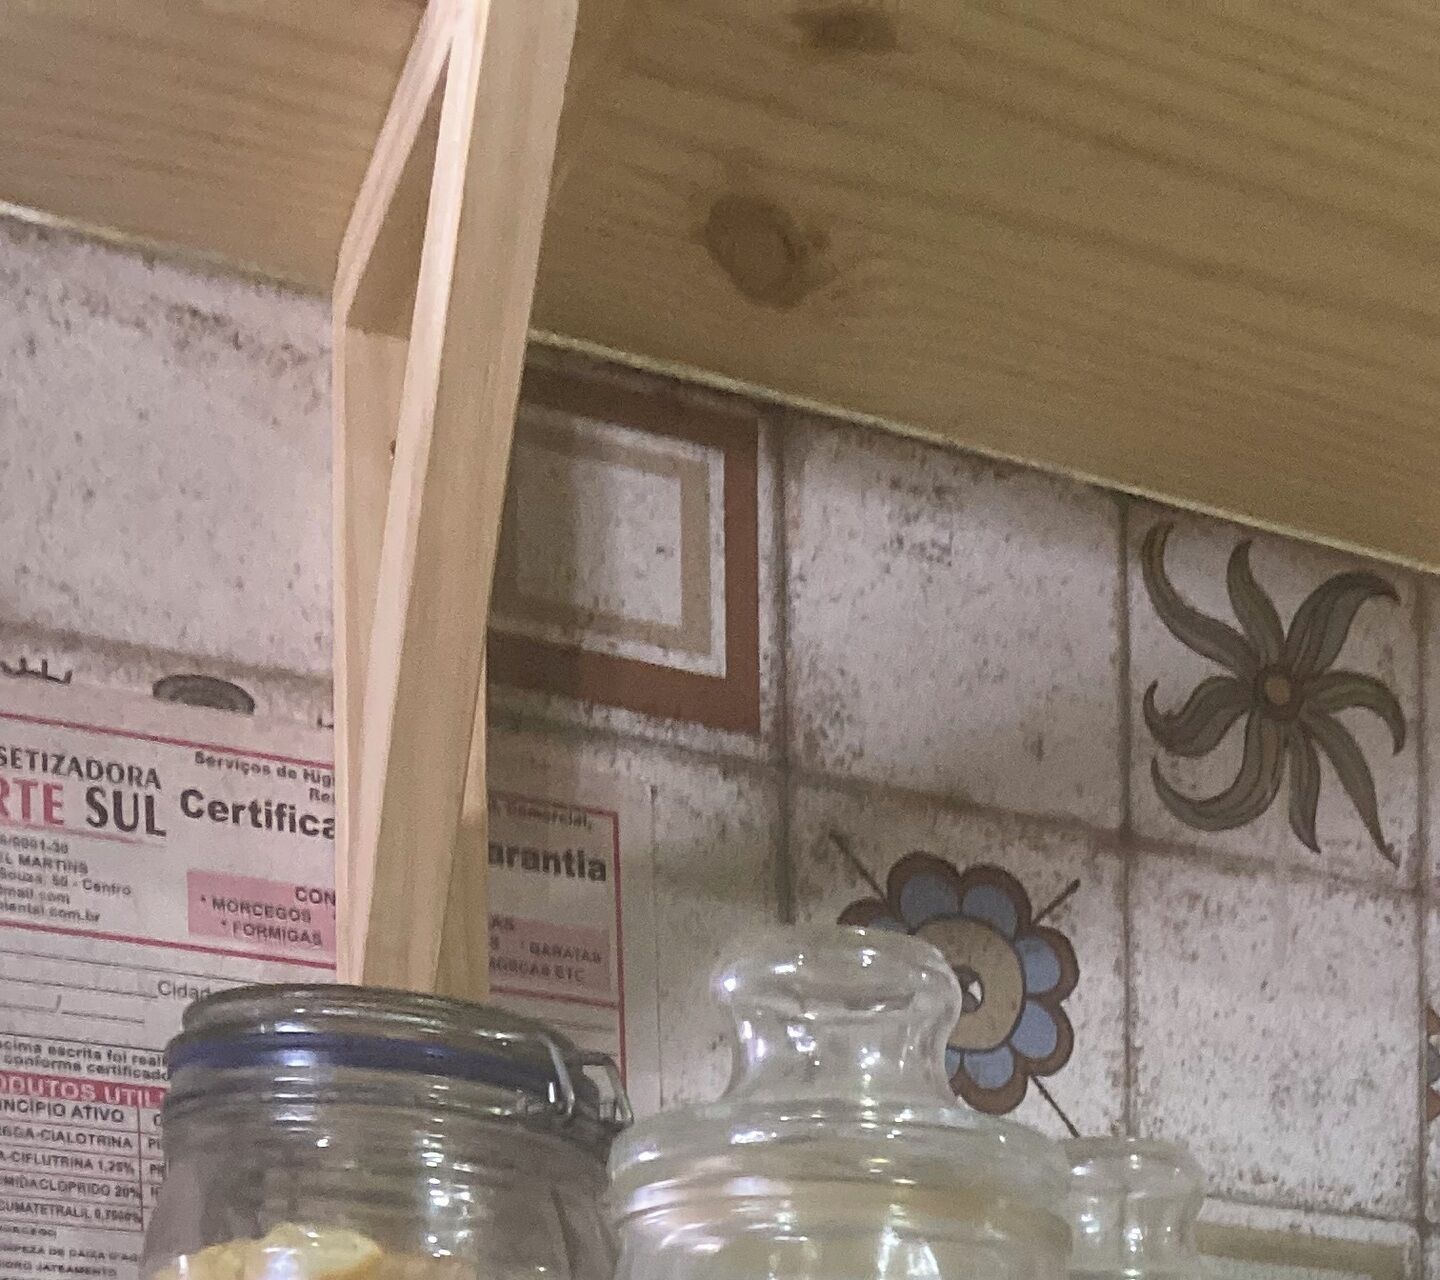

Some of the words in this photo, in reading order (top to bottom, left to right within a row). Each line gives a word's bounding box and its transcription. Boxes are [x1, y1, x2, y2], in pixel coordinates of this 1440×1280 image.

[0, 745, 162, 790] SETIZADORA
[276, 765, 297, 779] de
[86, 785, 167, 837] SUL
[180, 789, 335, 840] Certifica
[232, 920, 323, 947] FORMIGAS
[71, 1104, 125, 1124] ATIVO
